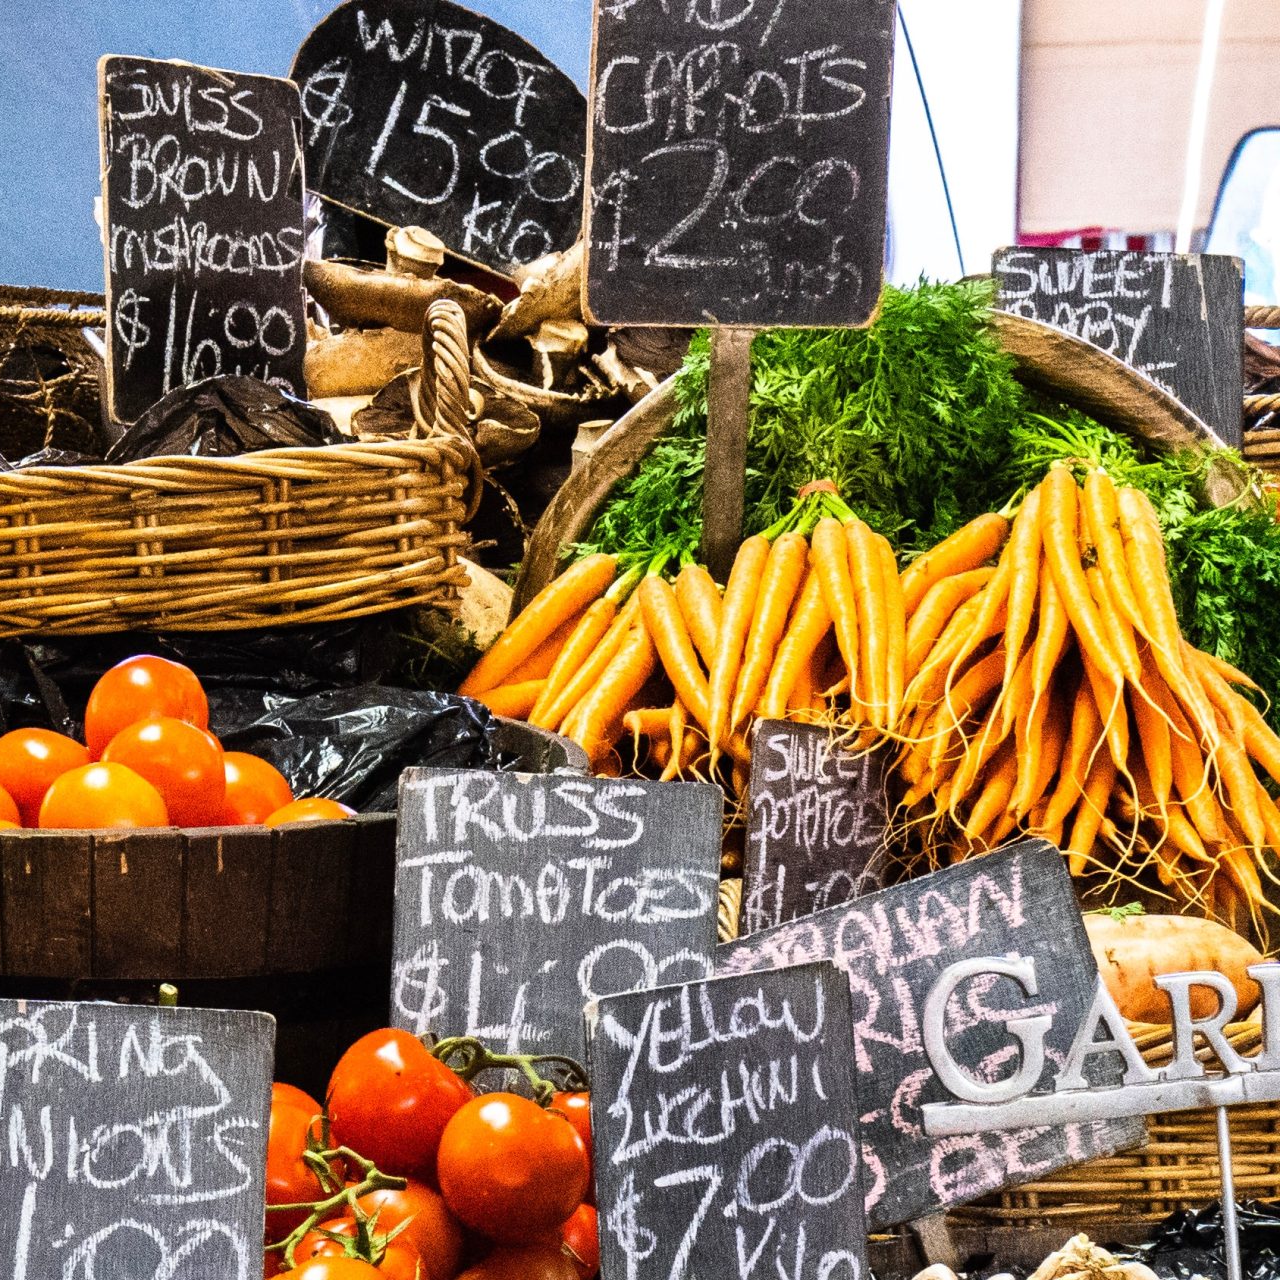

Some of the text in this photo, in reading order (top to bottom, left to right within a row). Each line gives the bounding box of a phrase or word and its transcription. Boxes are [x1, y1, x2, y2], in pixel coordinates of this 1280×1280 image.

[107, 69, 263, 141] SWISS
[117, 134, 280, 213] BROWN
[997, 252, 1172, 308] SWEET
[406, 771, 646, 849] TRUSS
